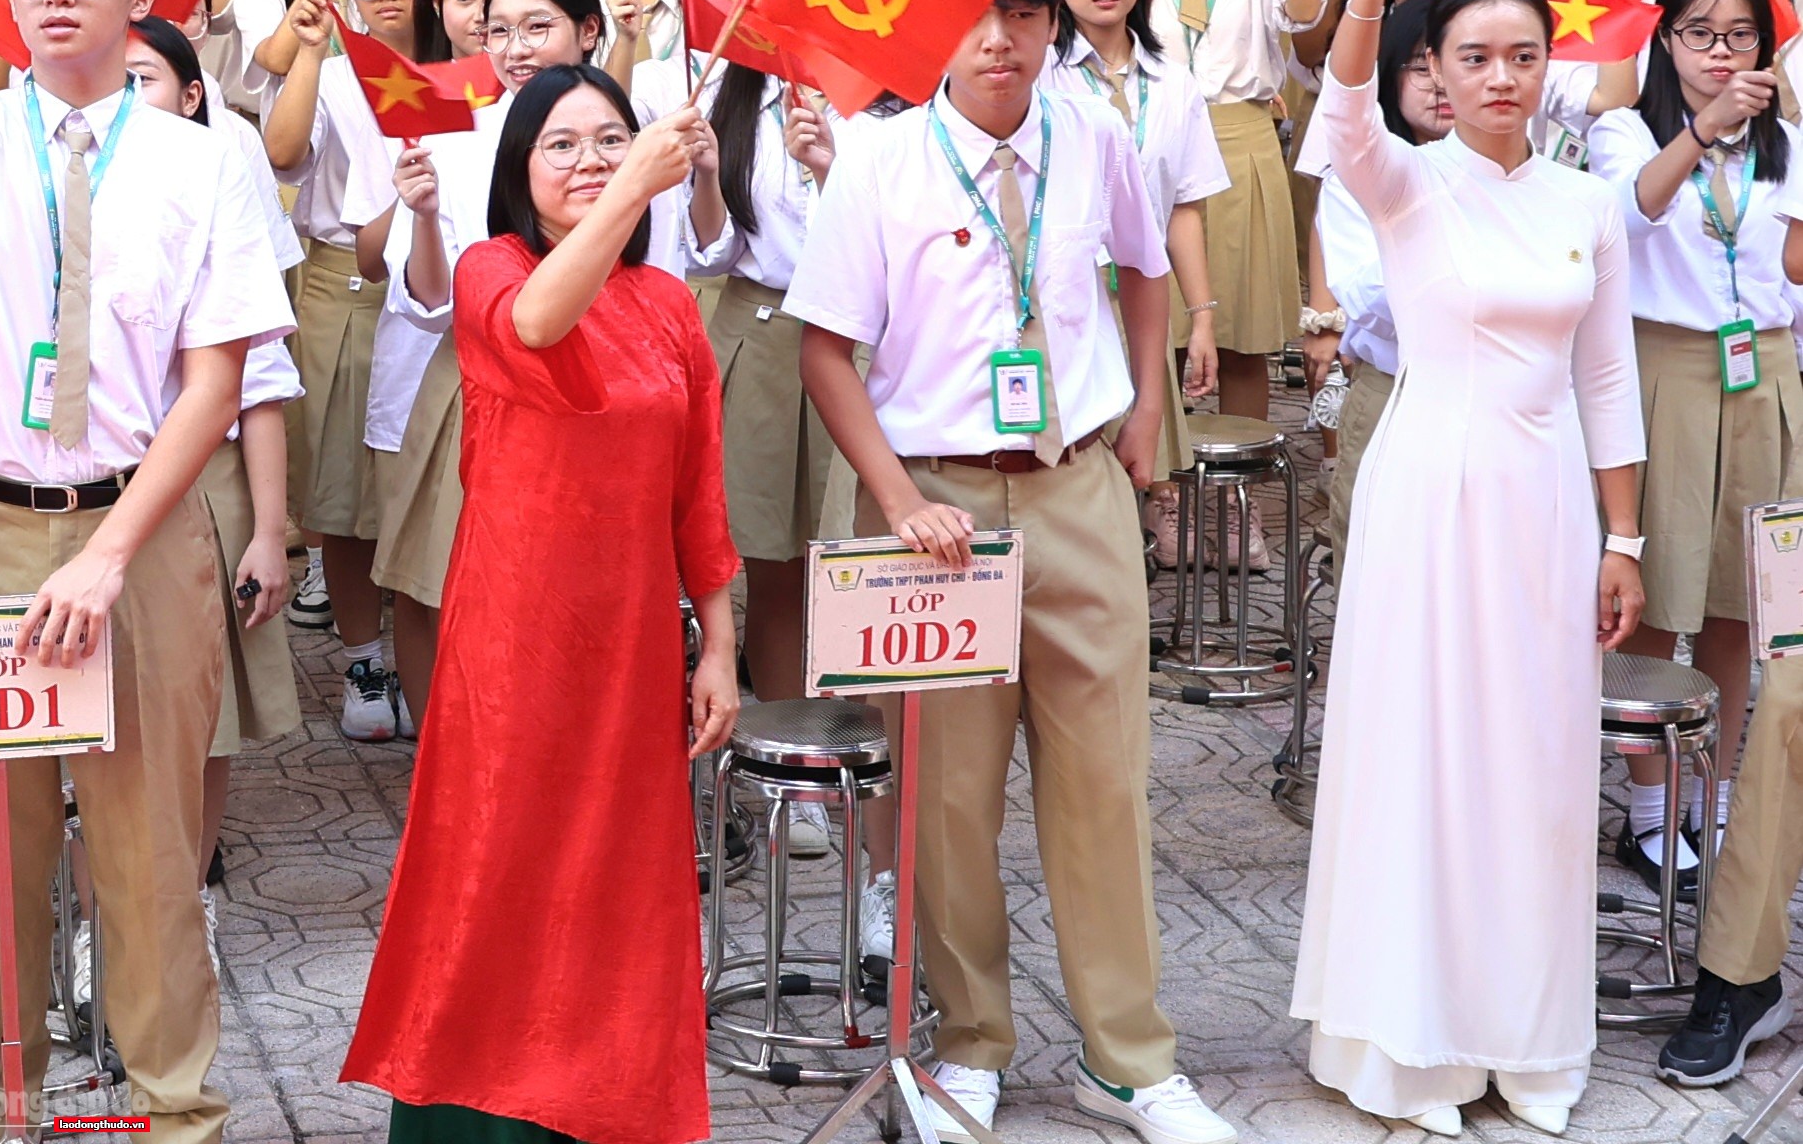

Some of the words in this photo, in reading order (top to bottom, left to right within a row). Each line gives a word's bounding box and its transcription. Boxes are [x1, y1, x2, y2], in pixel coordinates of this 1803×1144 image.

[865, 574, 893, 588] TRƯỜNG
[896, 576, 913, 587] THPT
[914, 574, 934, 585] PHAN
[935, 573, 950, 584] HUY
[972, 568, 992, 581] ĐỐNG
[993, 570, 1003, 580] ĐA
[889, 589, 945, 614] LỚP
[2, 622, 14, 632] VÀ
[857, 619, 978, 667] 10D2
